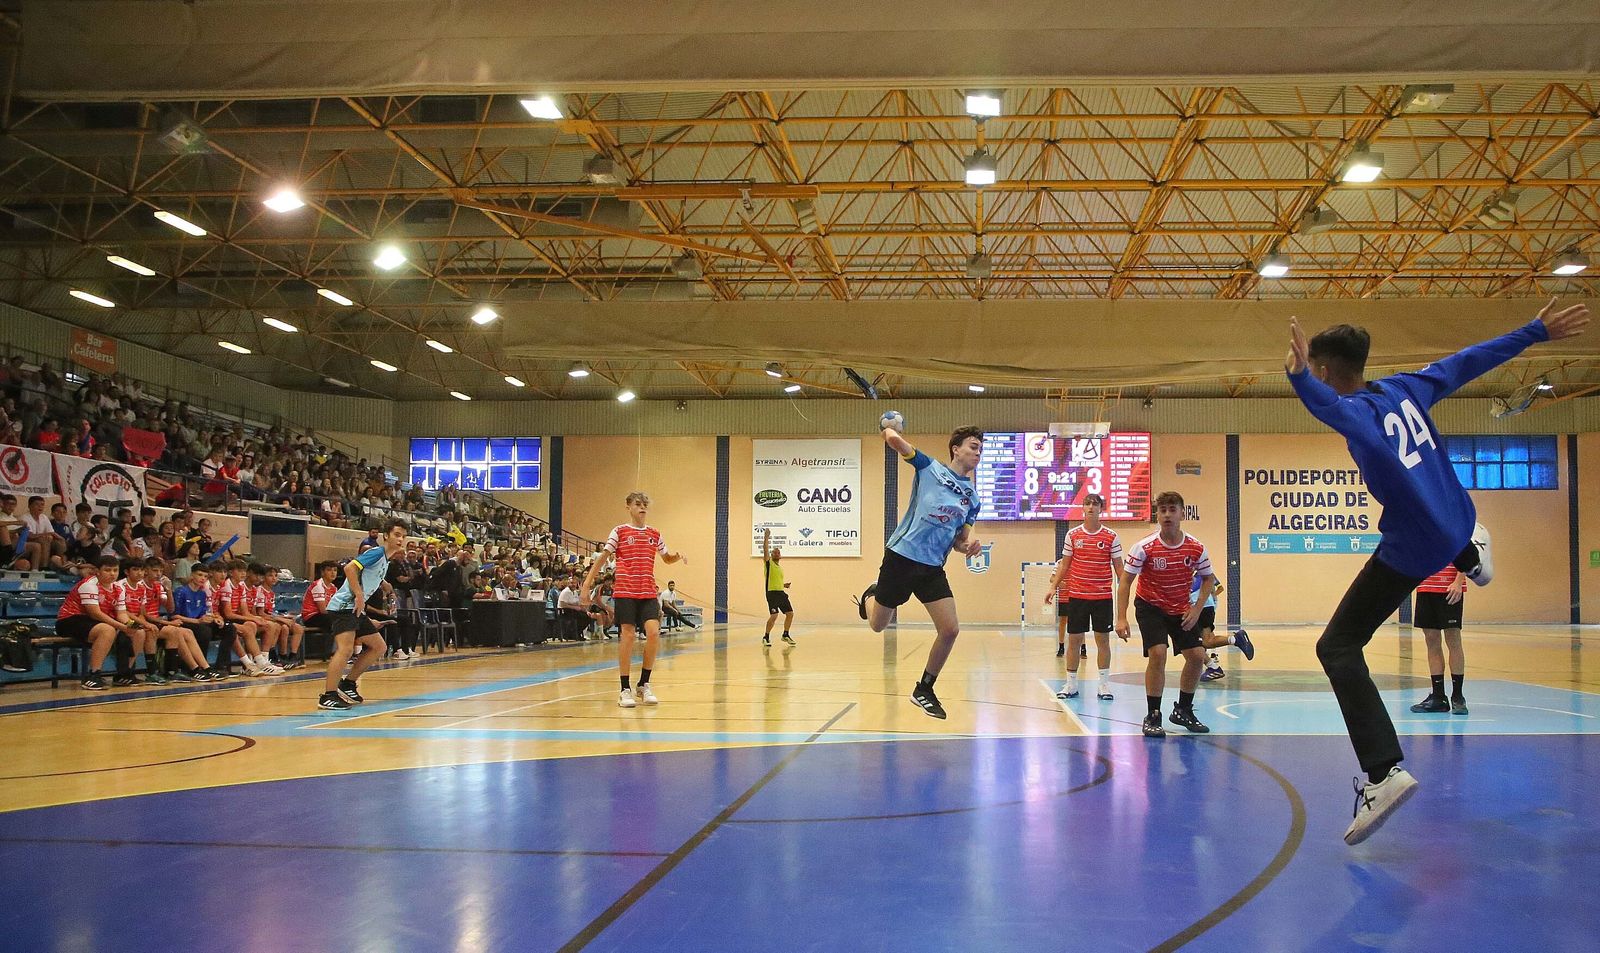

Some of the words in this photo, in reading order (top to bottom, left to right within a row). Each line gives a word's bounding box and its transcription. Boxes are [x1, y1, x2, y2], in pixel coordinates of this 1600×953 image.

[87, 333, 102, 347] Bar
[1383, 398, 1437, 470] 24
[791, 457, 846, 468] Algetransit
[89, 472, 131, 495] COLEGIO
[1024, 467, 1039, 495] 8
[1047, 472, 1077, 484] 9:21
[1086, 467, 1102, 495] 3
[1244, 469, 1365, 485] POLIDEPORTI
[797, 485, 852, 503] CANÓ
[1059, 492, 1066, 501] 1
[1270, 491, 1339, 508] CIUDAD
[1345, 491, 1368, 507] DE
[798, 505, 816, 513] Auto
[817, 505, 851, 513] Escuelas
[1268, 514, 1370, 531] ALGECIRAS
